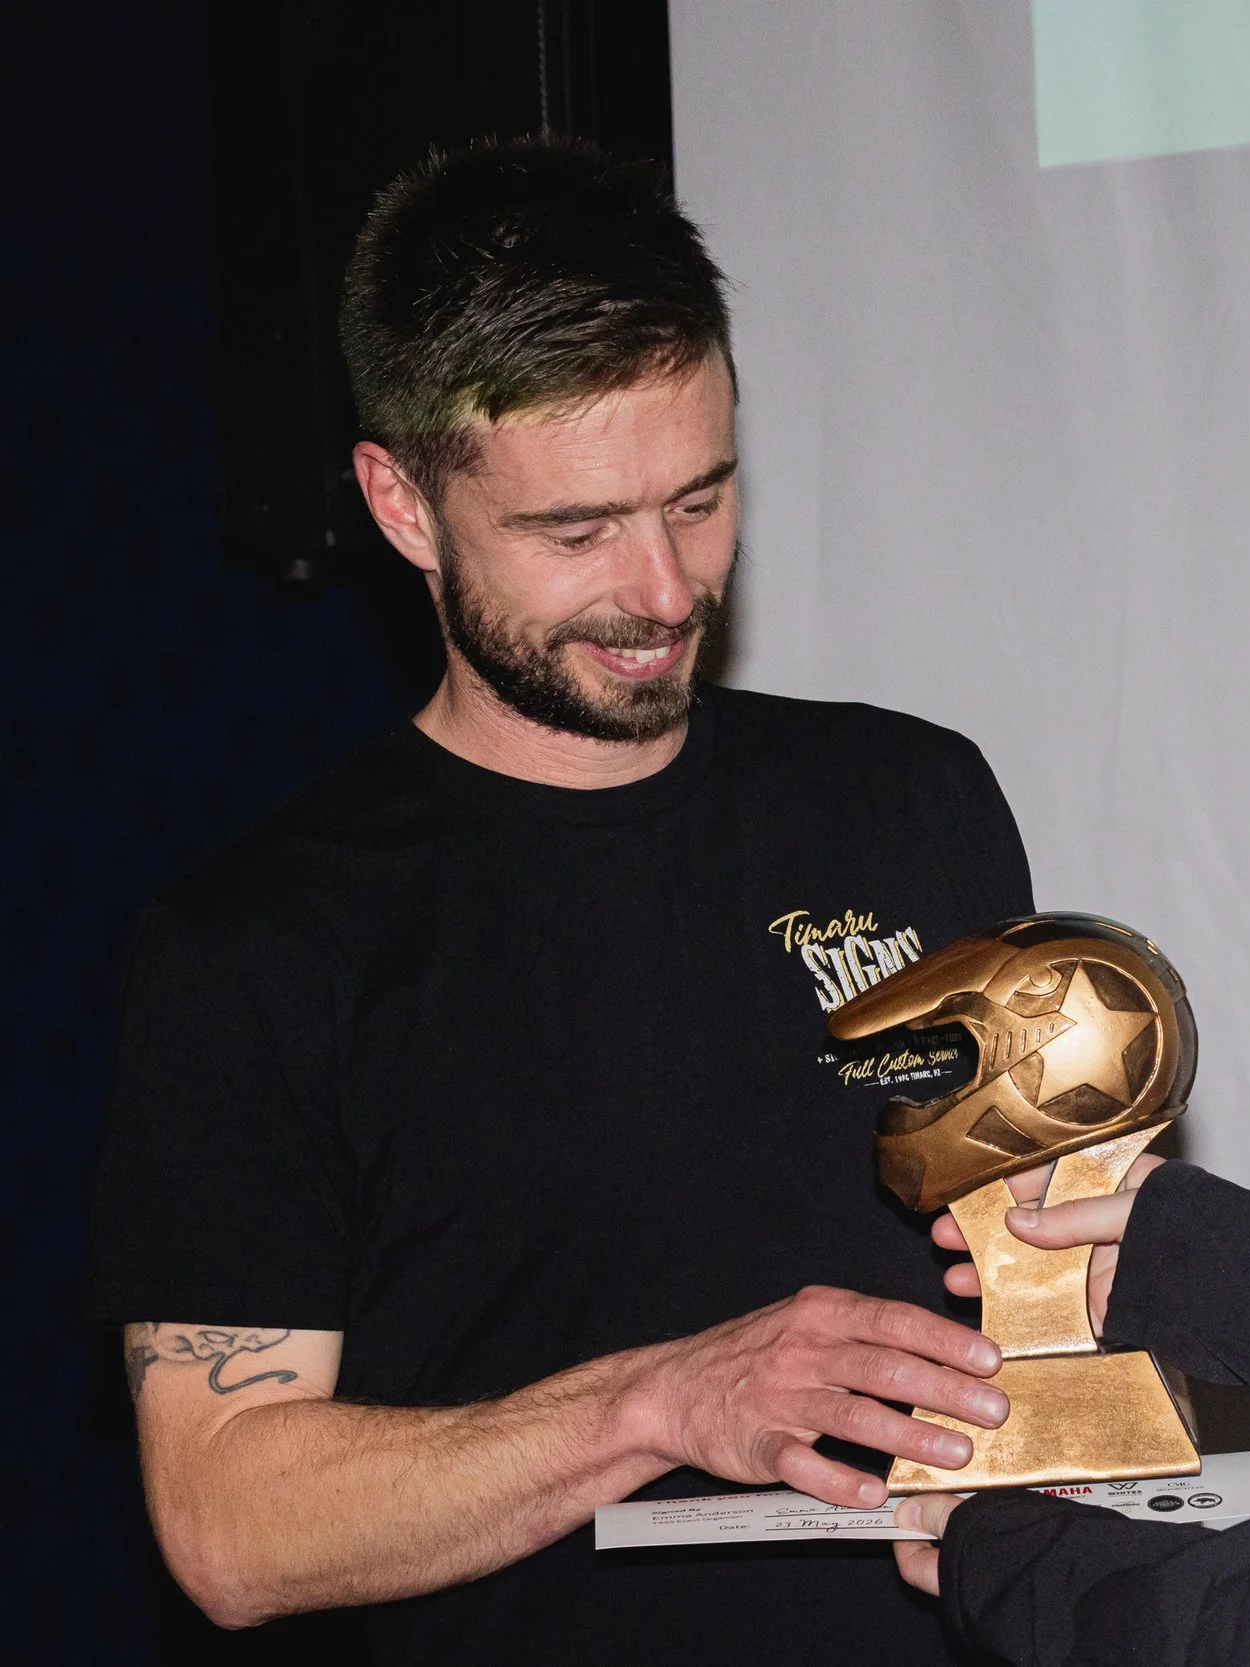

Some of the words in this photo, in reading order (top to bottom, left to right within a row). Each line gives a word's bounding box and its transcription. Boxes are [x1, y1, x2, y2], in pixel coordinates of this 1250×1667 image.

[768, 909, 878, 953] Timaru
[838, 1056, 876, 1086] Full
[877, 1048, 925, 1079] Custom
[1040, 1486, 1093, 1497] MAHA
[1107, 1489, 1143, 1497] WHITES
[652, 1513, 692, 1521] Emma
[695, 1508, 754, 1518] Anderson
[775, 1506, 820, 1515] Emma
[719, 1523, 751, 1531] Date:
[800, 1518, 840, 1533] May
[848, 1517, 884, 1526] 2026
